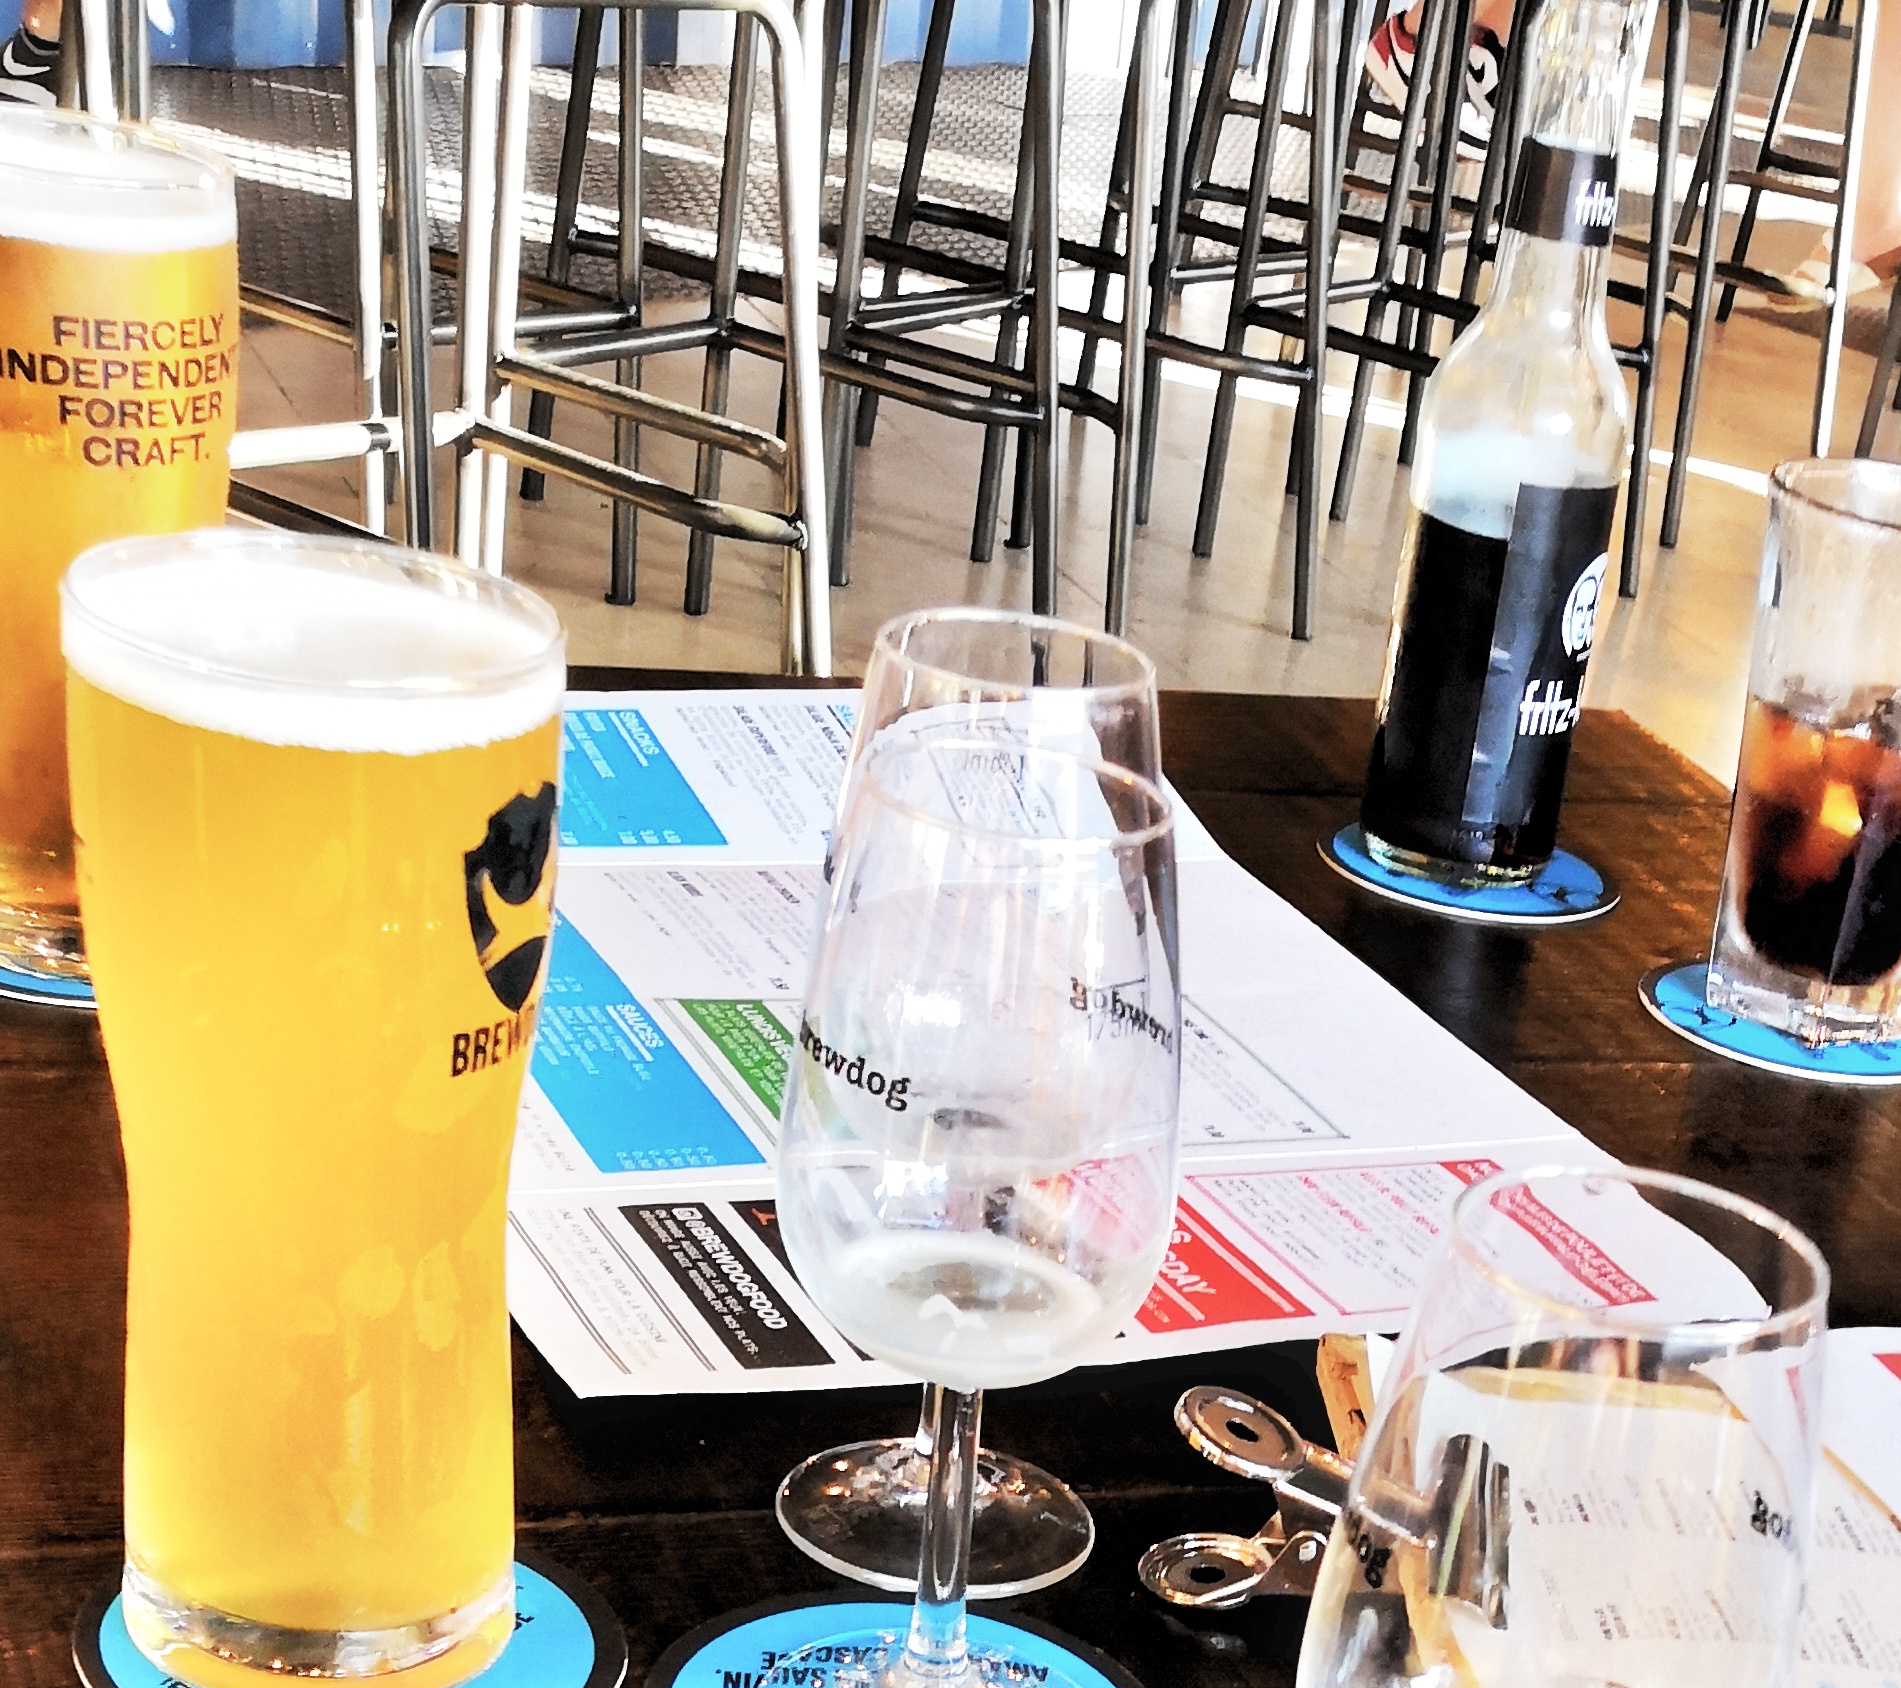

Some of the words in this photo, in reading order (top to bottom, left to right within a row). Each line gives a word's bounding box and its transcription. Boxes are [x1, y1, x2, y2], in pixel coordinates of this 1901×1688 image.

[53, 313, 224, 351] FIERCELY
[0, 346, 237, 390] INDEPENDEN
[58, 390, 222, 429] FOREVER
[83, 432, 209, 468] CRAFT.
[616, 1003, 664, 1048] SAUCES
